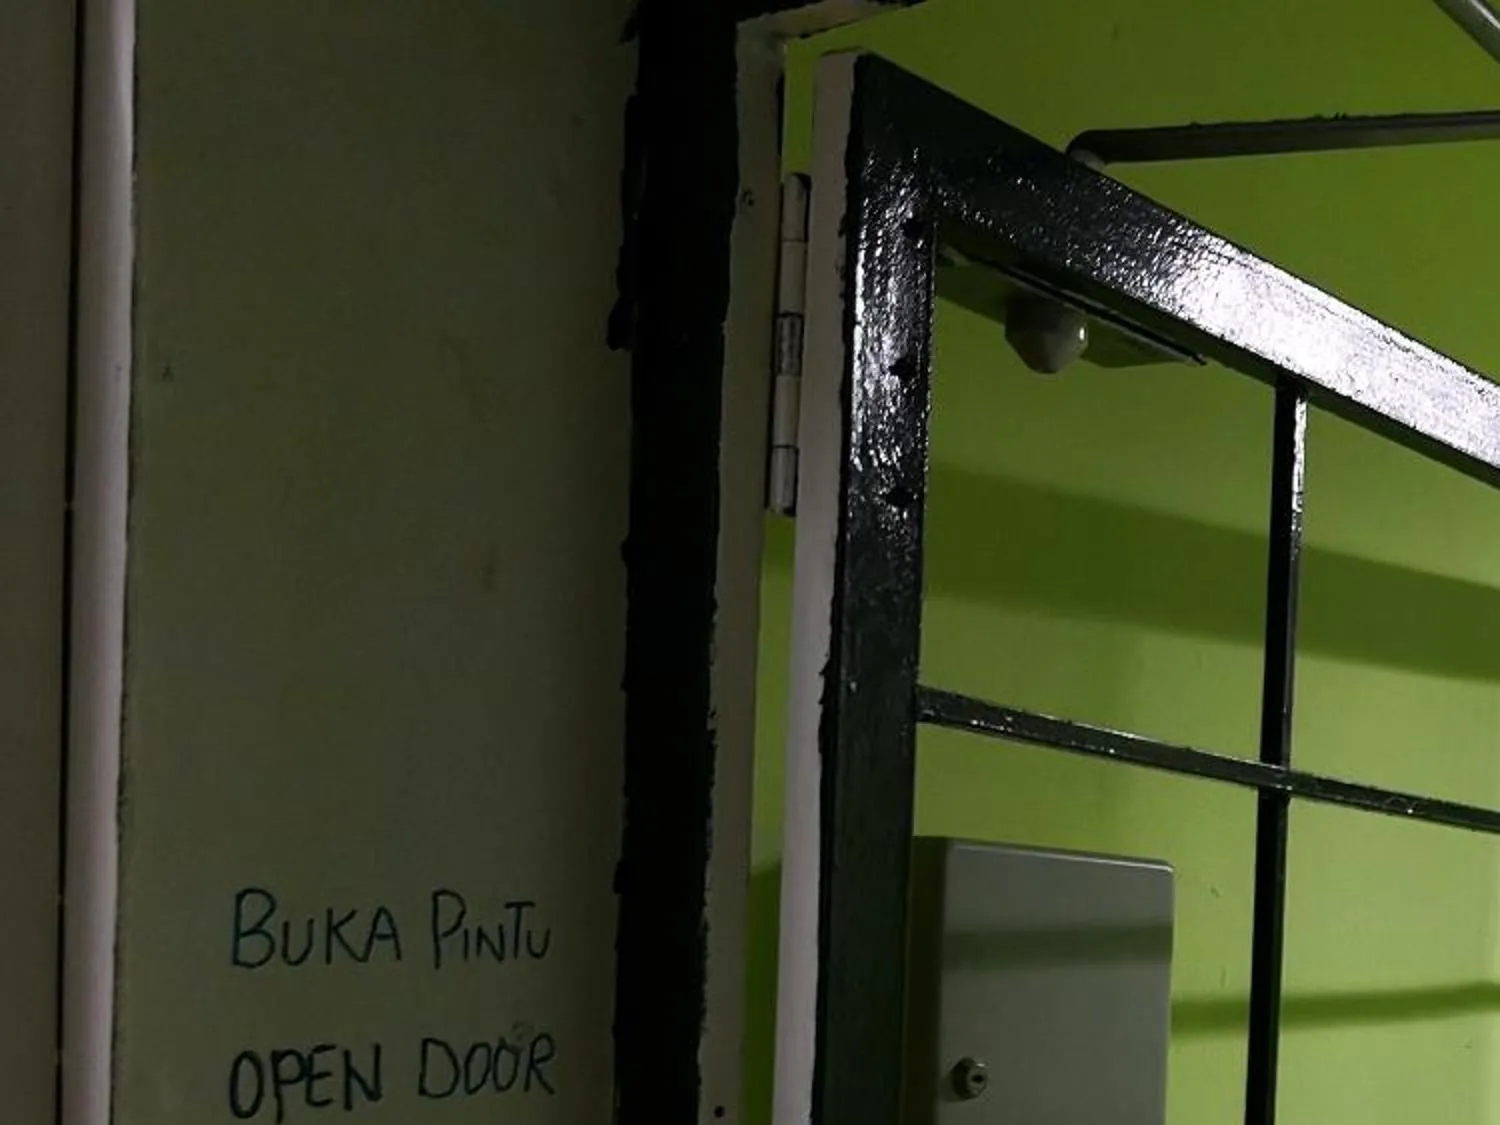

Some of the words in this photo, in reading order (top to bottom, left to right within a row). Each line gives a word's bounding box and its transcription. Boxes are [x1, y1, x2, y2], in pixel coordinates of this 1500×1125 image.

[231, 886, 402, 969] BUKA
[431, 888, 552, 970] PINTU
[228, 1042, 384, 1125] OPEN
[417, 1032, 556, 1099] DOOR
